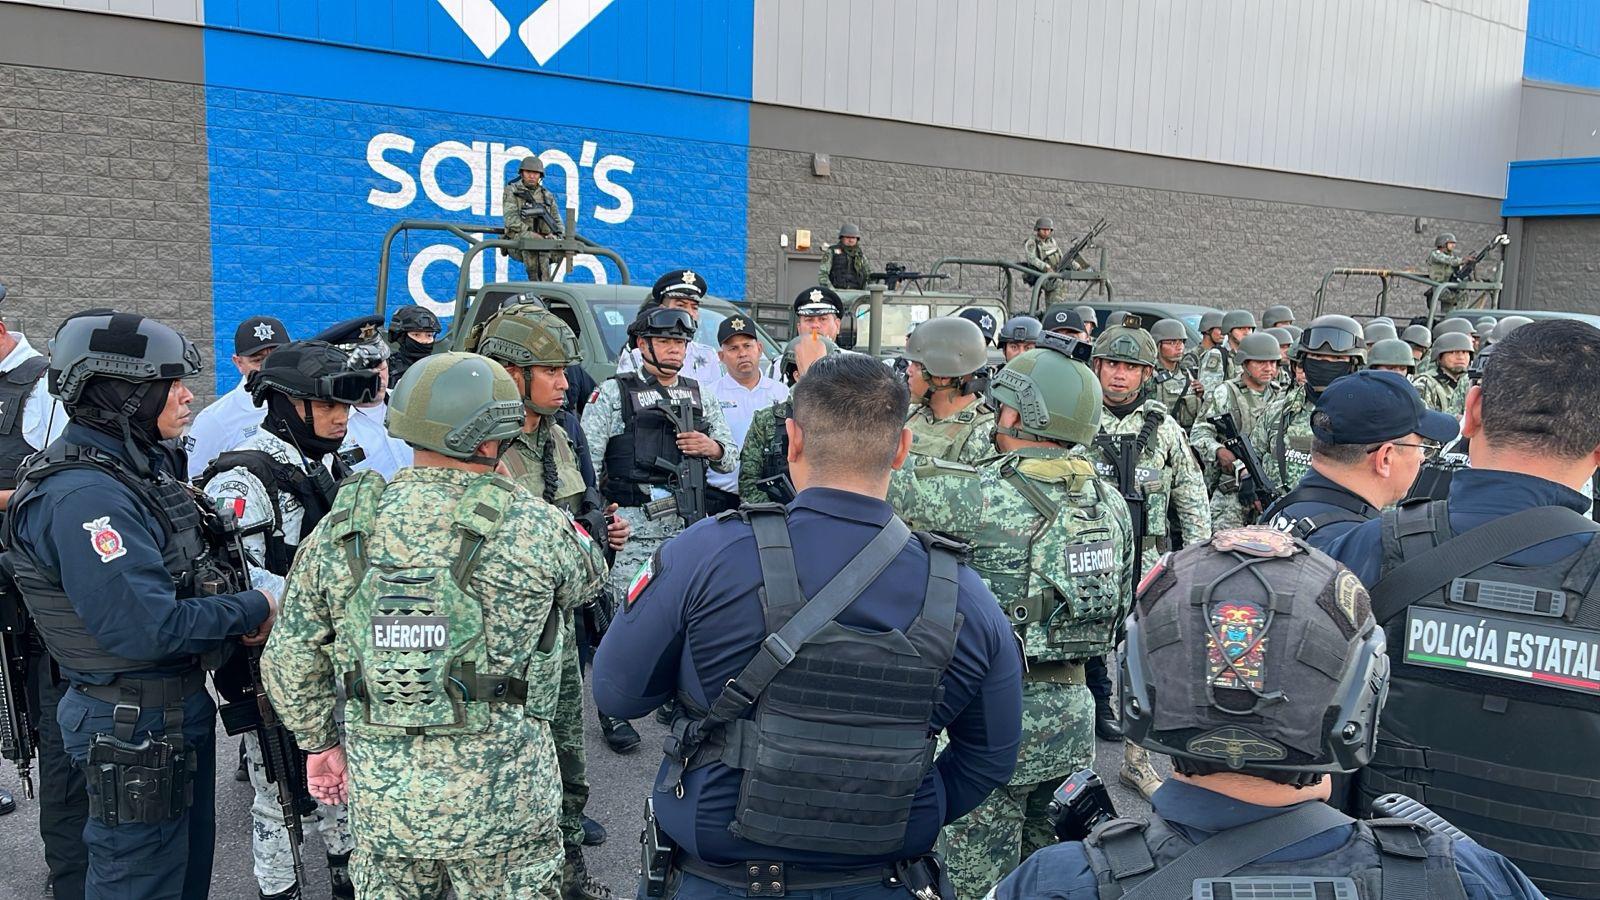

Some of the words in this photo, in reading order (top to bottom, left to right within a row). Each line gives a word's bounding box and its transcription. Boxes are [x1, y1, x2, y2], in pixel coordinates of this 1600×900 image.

[366, 132, 635, 224] sam's
[1069, 547, 1113, 573] EJÉRCITO
[374, 620, 446, 648] EJÉRCITO
[1408, 619, 1498, 663] POLICÍA
[1504, 631, 1600, 681] ESTATAL
